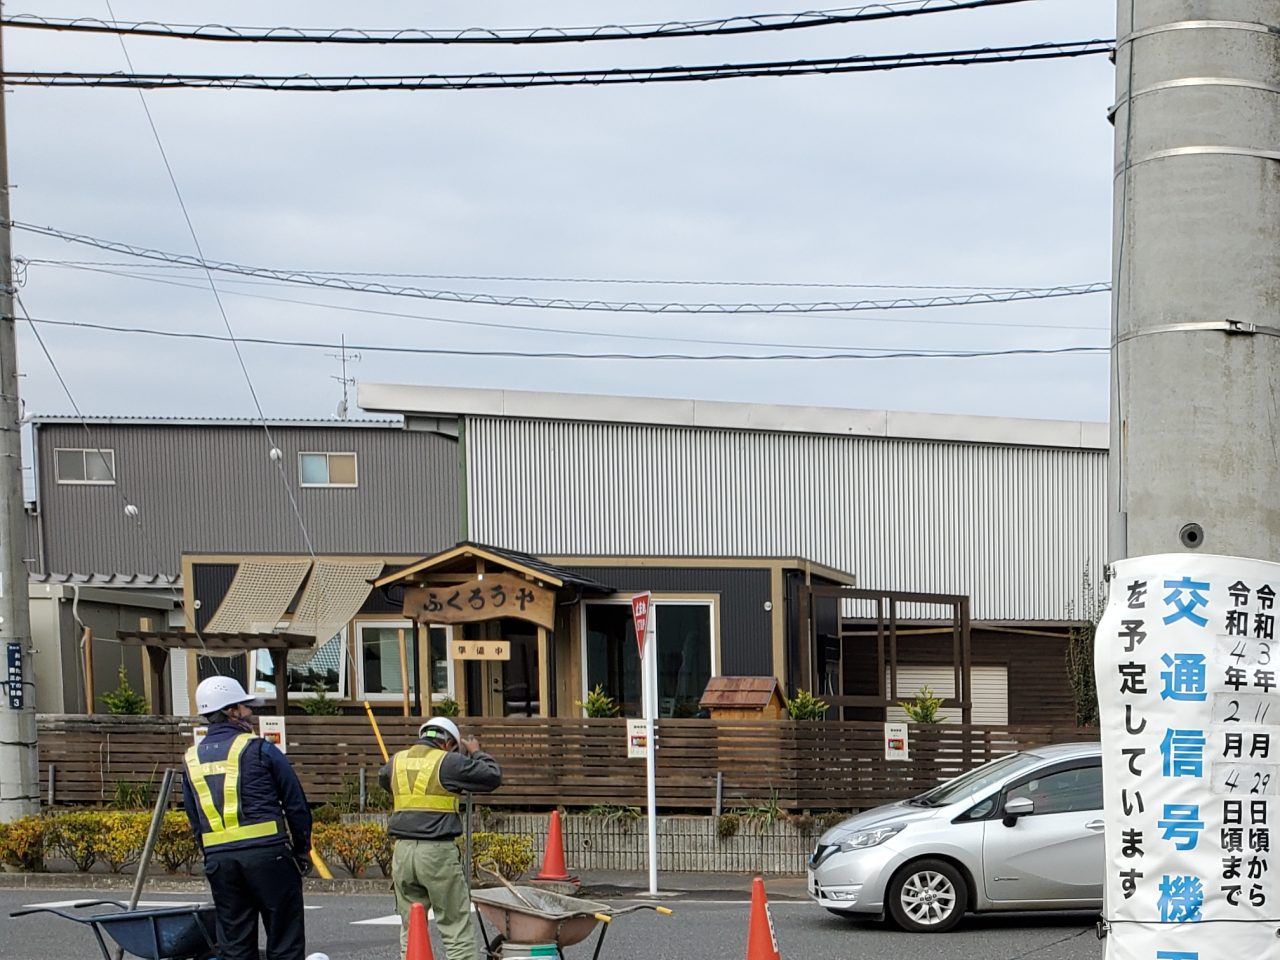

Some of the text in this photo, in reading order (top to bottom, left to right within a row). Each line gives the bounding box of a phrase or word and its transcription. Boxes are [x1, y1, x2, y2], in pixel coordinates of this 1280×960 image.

[423, 583, 536, 613] ふくろうや
[13, 698, 20, 707] 3
[1117, 579, 1148, 900] を予定しています
